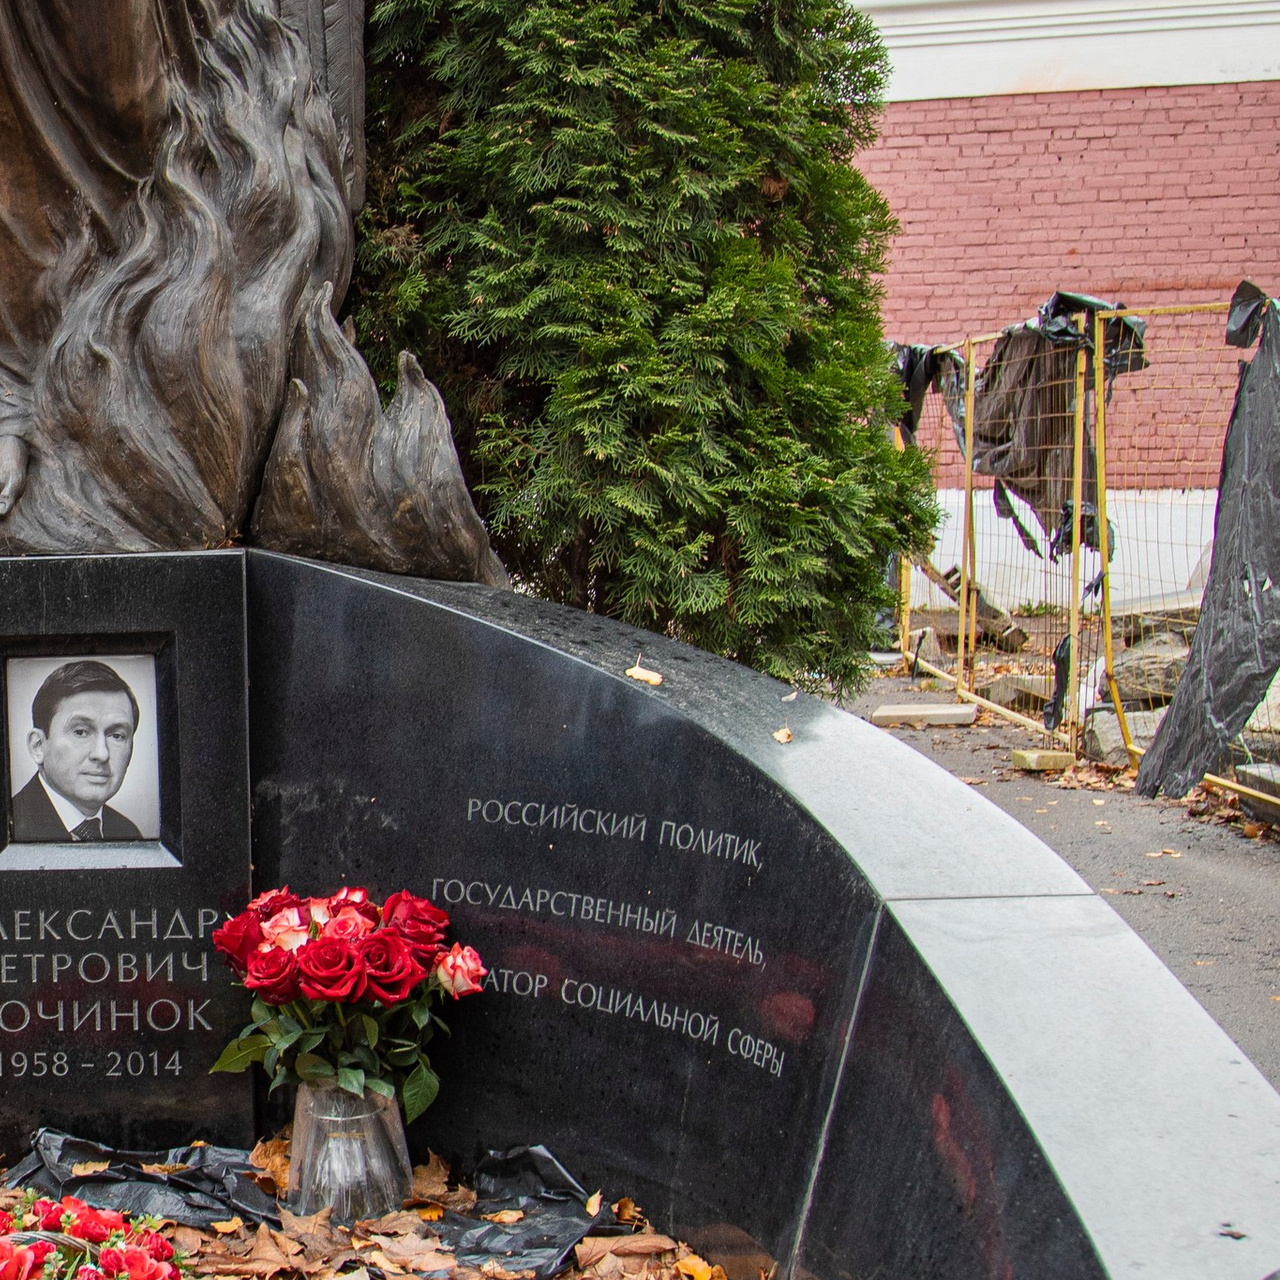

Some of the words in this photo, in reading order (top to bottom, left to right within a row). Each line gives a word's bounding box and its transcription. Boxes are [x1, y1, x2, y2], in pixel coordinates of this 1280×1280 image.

[467, 797, 647, 843] РОССИЙСКИЙ
[659, 820, 764, 872] ПОЛИТИК,
[432, 877, 676, 939] ГОСУДАРСТВЕННЫЙ
[686, 920, 767, 972] ДЕЯТЕЛЬ,
[105, 1051, 183, 1077] 2014
[561, 978, 719, 1048] СОЦИАЛЬНОЙ
[727, 1027, 785, 1078] СФЕРЫ
